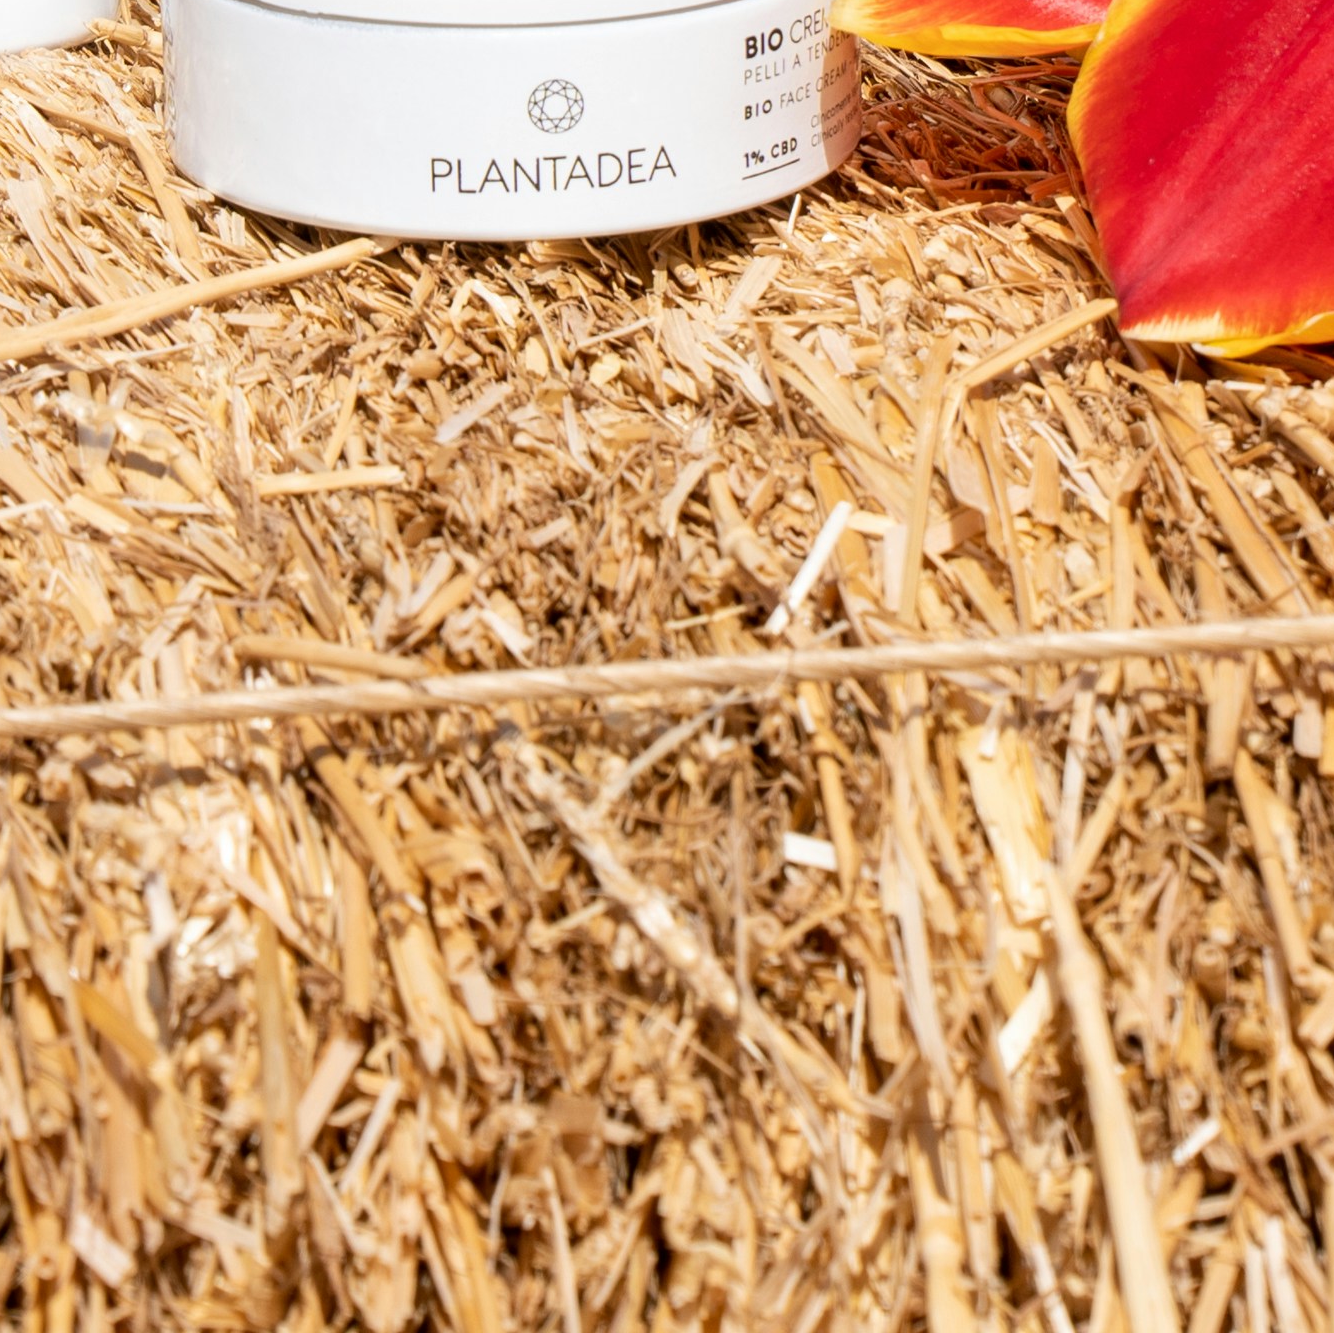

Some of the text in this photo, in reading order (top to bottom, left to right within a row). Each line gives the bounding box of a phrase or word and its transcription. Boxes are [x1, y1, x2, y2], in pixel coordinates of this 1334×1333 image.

[745, 28, 783, 59] BIO
[744, 59, 785, 85] PELLI
[793, 54, 801, 69] A
[745, 99, 772, 120] BIO
[780, 83, 811, 109] FACE
[816, 61, 847, 93] CREAM
[744, 137, 797, 168] 1% CBD
[431, 146, 676, 194] PLANTADEA
